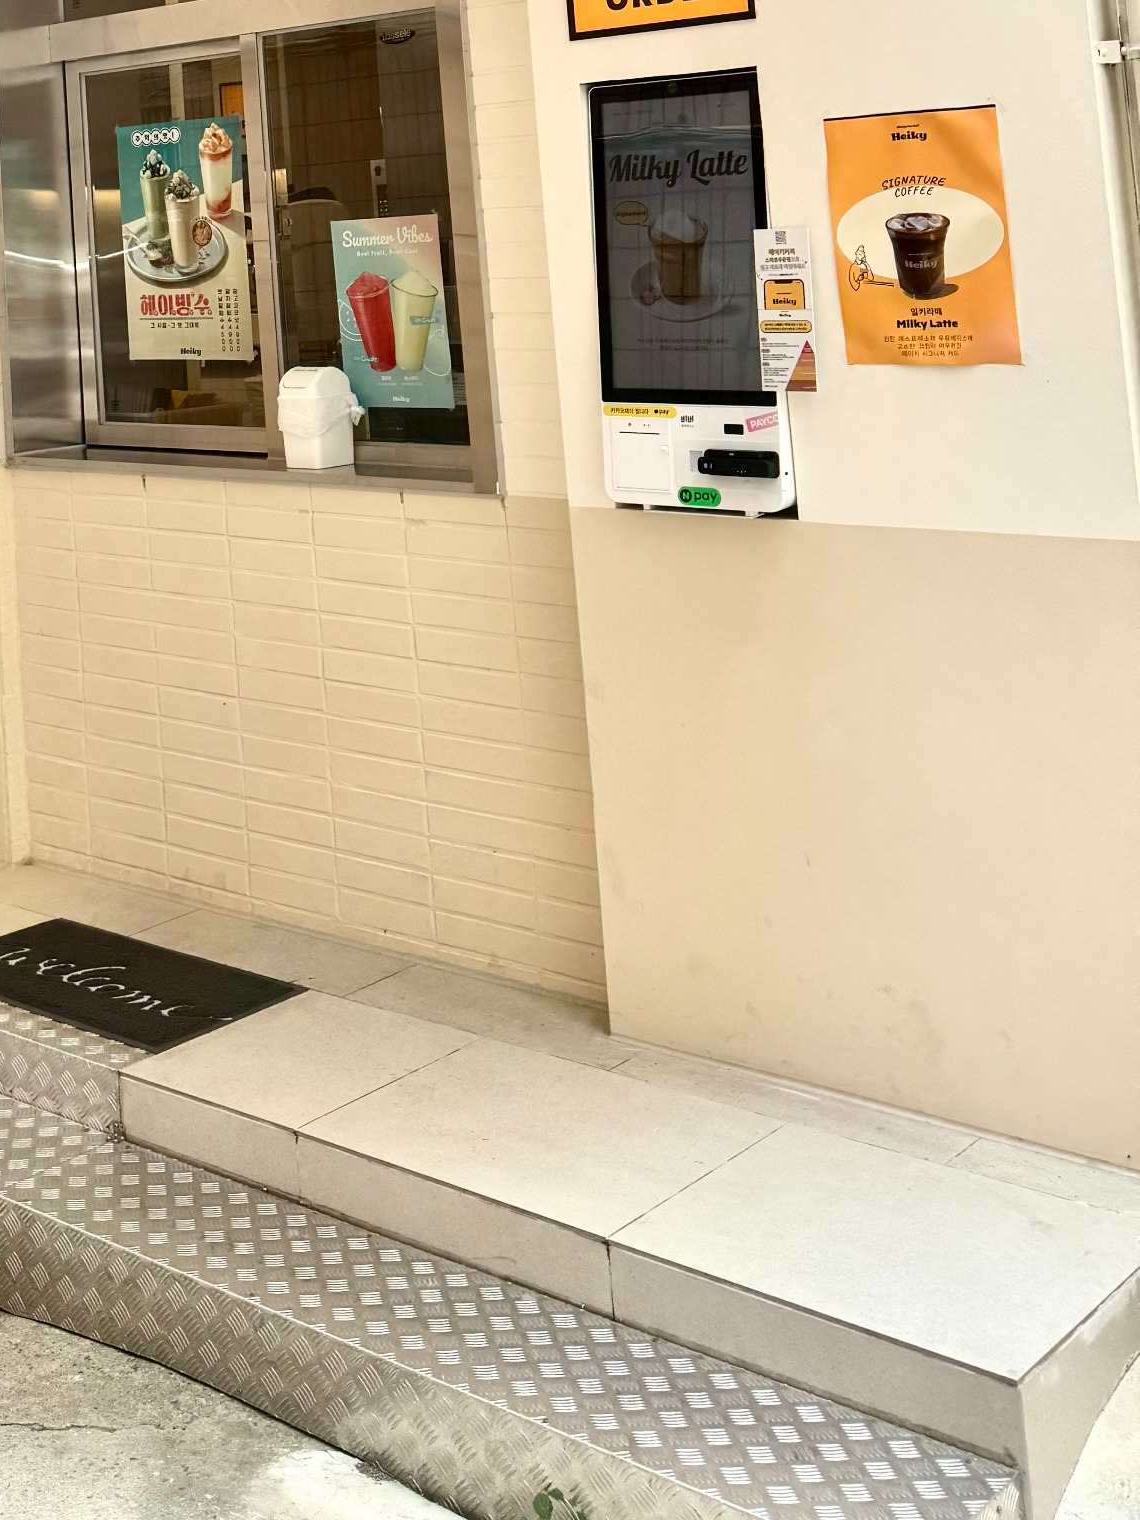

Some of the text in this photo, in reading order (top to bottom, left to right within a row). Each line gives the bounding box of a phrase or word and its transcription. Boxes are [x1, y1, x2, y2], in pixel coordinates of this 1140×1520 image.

[890, 130, 927, 142] Heiky
[608, 149, 749, 188] Milky Latte
[881, 175, 947, 191] SIGNATURE
[894, 186, 935, 198] COFFEE
[342, 224, 434, 248] Summer Vibes
[904, 259, 938, 269] Heiky
[140, 291, 212, 317] 헤이빙수
[772, 297, 797, 306] Heiky
[896, 319, 959, 330] Milky Latte
[180, 347, 202, 357] Heiky
[694, 490, 718, 503] pay
